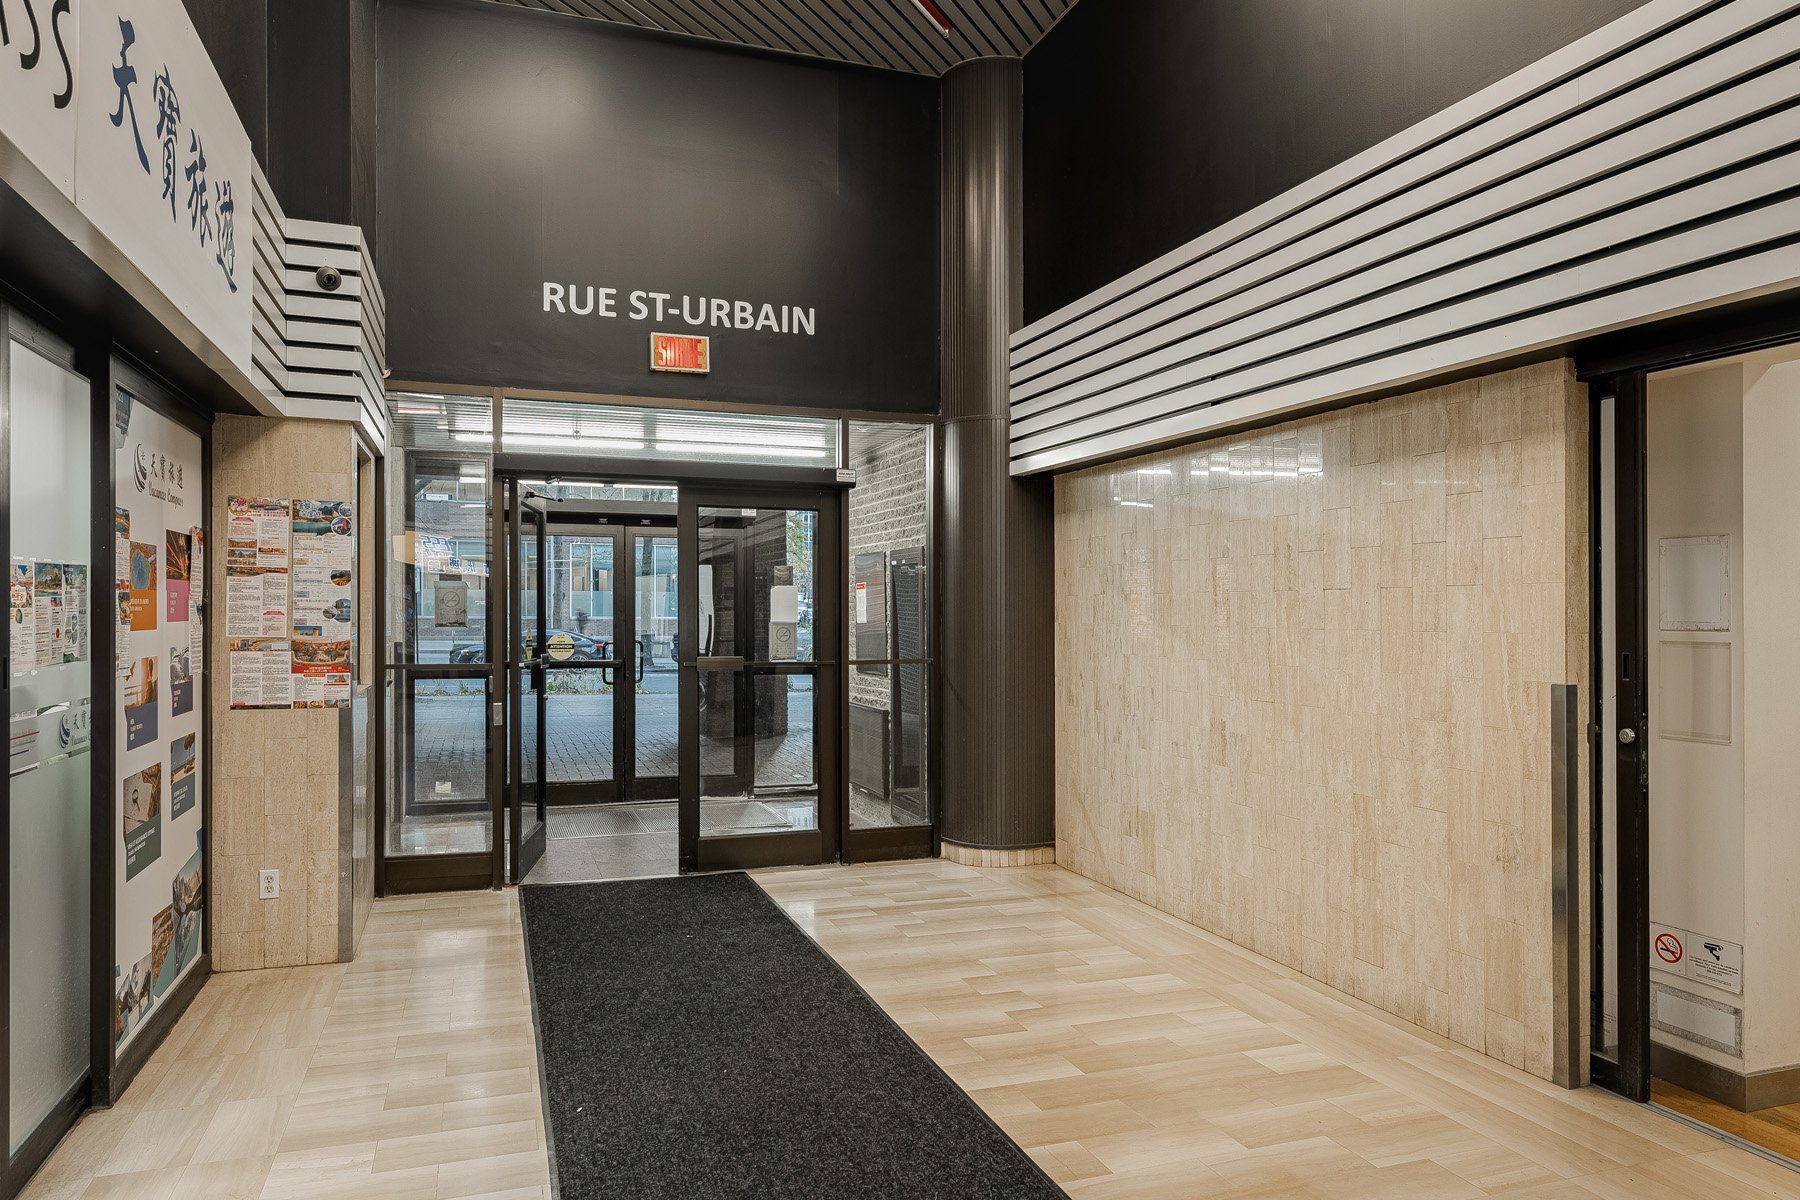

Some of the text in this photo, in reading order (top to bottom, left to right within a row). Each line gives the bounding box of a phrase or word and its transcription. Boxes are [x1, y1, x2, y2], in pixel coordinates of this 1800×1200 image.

[0, 0, 73, 109] SS
[543, 282, 816, 335] RUE ST-URBAIN
[657, 336, 704, 369] SORTIE
